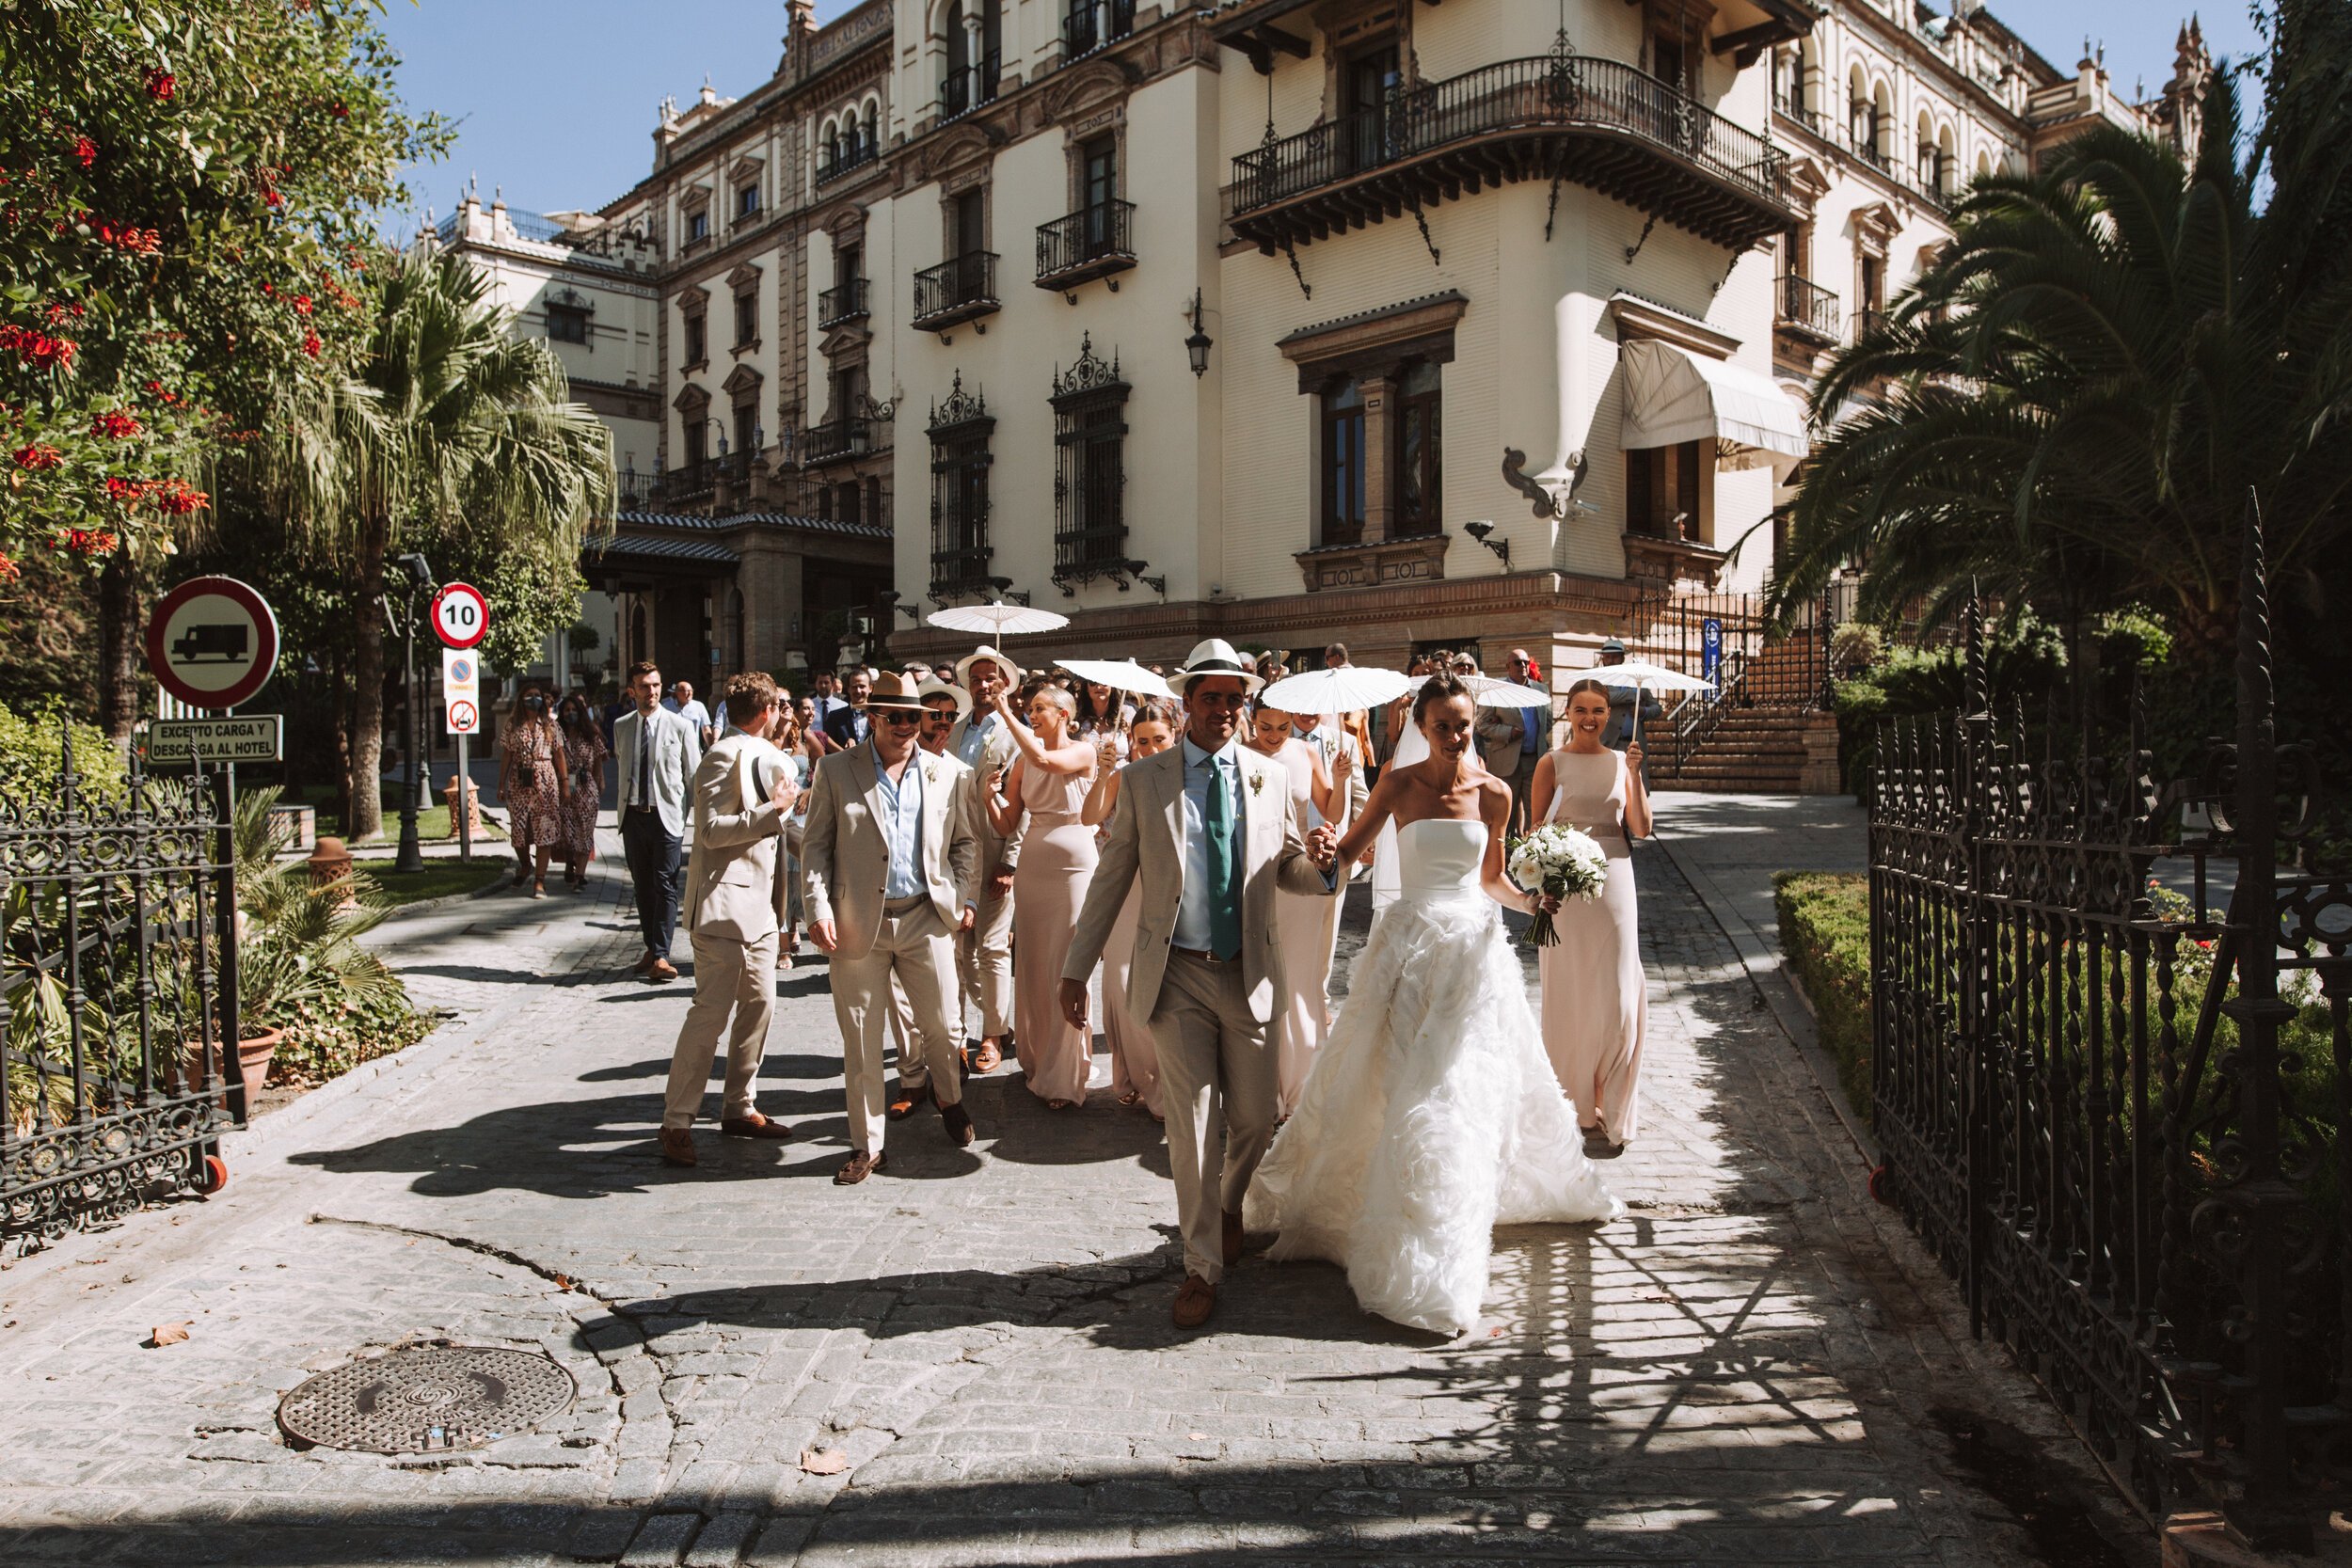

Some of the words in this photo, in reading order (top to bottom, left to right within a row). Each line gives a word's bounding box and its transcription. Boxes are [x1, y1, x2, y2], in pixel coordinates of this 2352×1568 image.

[445, 605, 475, 626] 10
[161, 725, 213, 738] EXCEPTO
[215, 723, 254, 736] CARGA
[257, 723, 265, 735] Y
[153, 745, 214, 756] DESCAGA
[217, 743, 232, 754] AL
[235, 741, 272, 753] HOTEL
